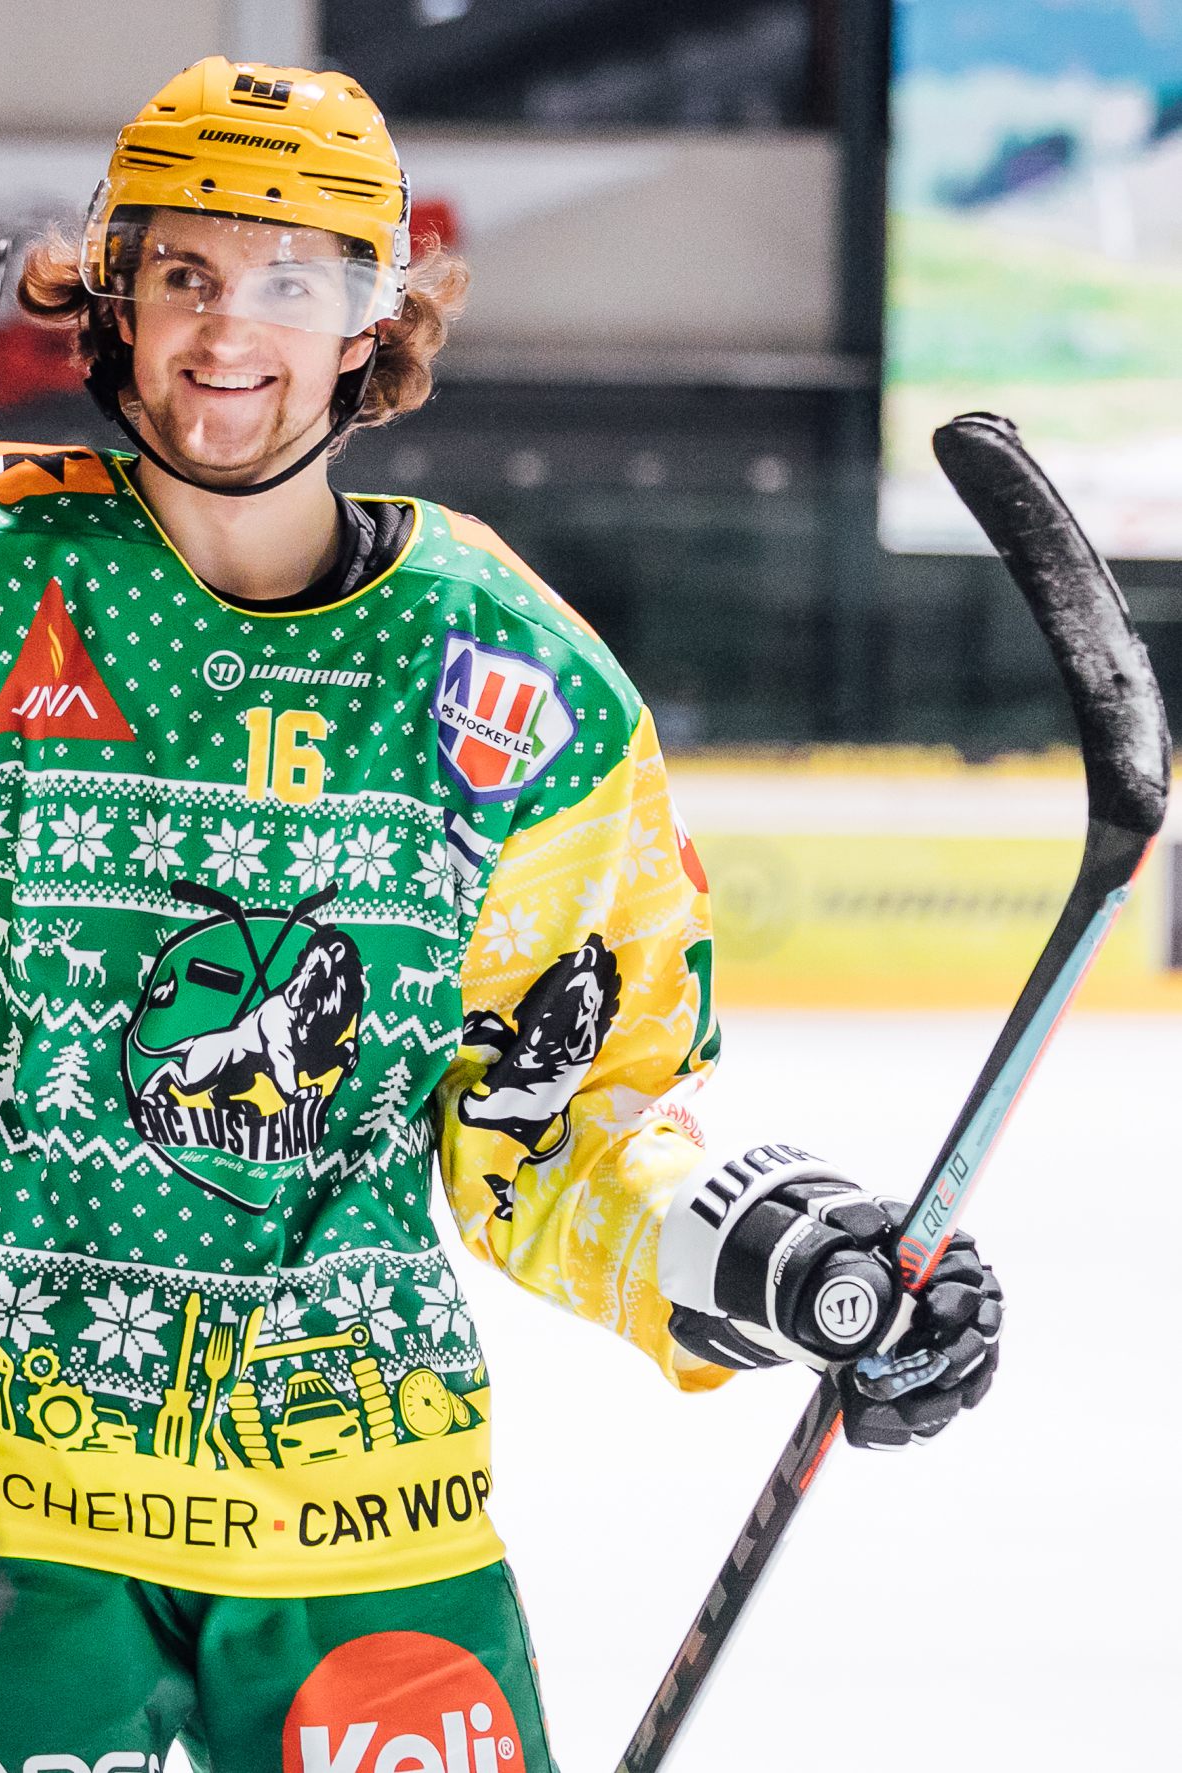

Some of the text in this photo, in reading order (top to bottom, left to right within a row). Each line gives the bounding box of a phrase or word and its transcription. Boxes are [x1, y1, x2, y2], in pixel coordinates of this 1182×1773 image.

[198, 129, 301, 154] WARRIOR
[249, 664, 372, 688] WARRIOR
[245, 706, 328, 806] 16
[456, 712, 513, 747] HOCKEY
[513, 740, 532, 755] LE
[139, 1099, 325, 1161] EHC LUSTENAU
[178, 1151, 209, 1163] Hier
[211, 1157, 244, 1173] spielt
[247, 1166, 268, 1180] die
[922, 1151, 969, 1238] QRE 10
[298, 1494, 392, 1547] CAR
[398, 1467, 493, 1532] WOR
